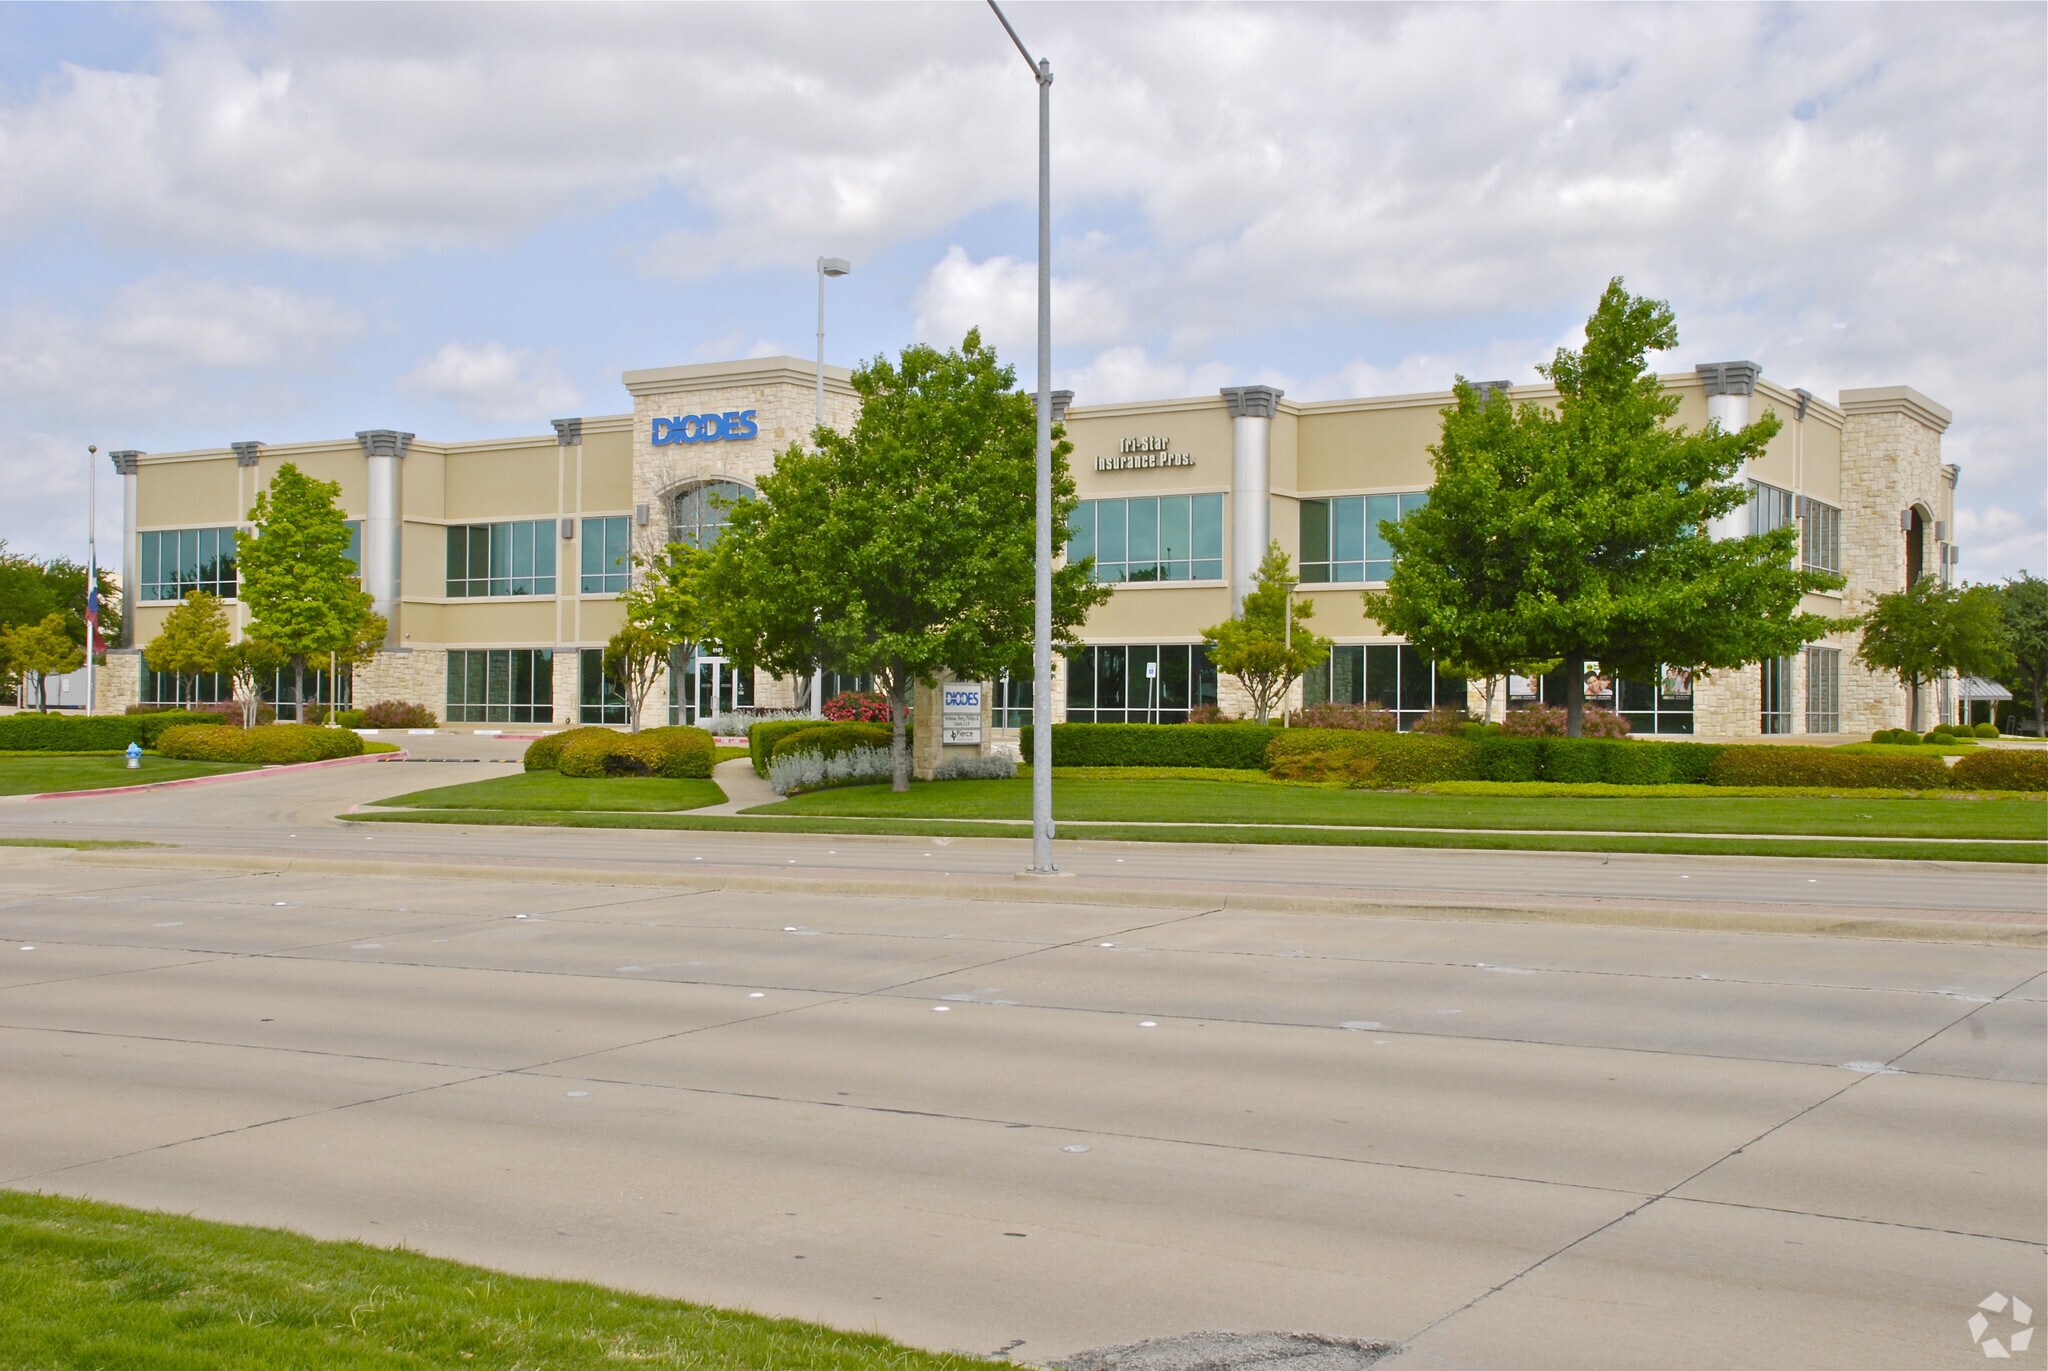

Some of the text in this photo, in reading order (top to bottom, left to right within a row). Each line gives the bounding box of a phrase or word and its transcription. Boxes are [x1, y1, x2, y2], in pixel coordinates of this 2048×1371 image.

[652, 409, 759, 446] DIODES
[1120, 436, 1169, 453] Tri-Star
[1094, 451, 1195, 471] Insurance Pros.
[945, 691, 979, 706] DIODES
